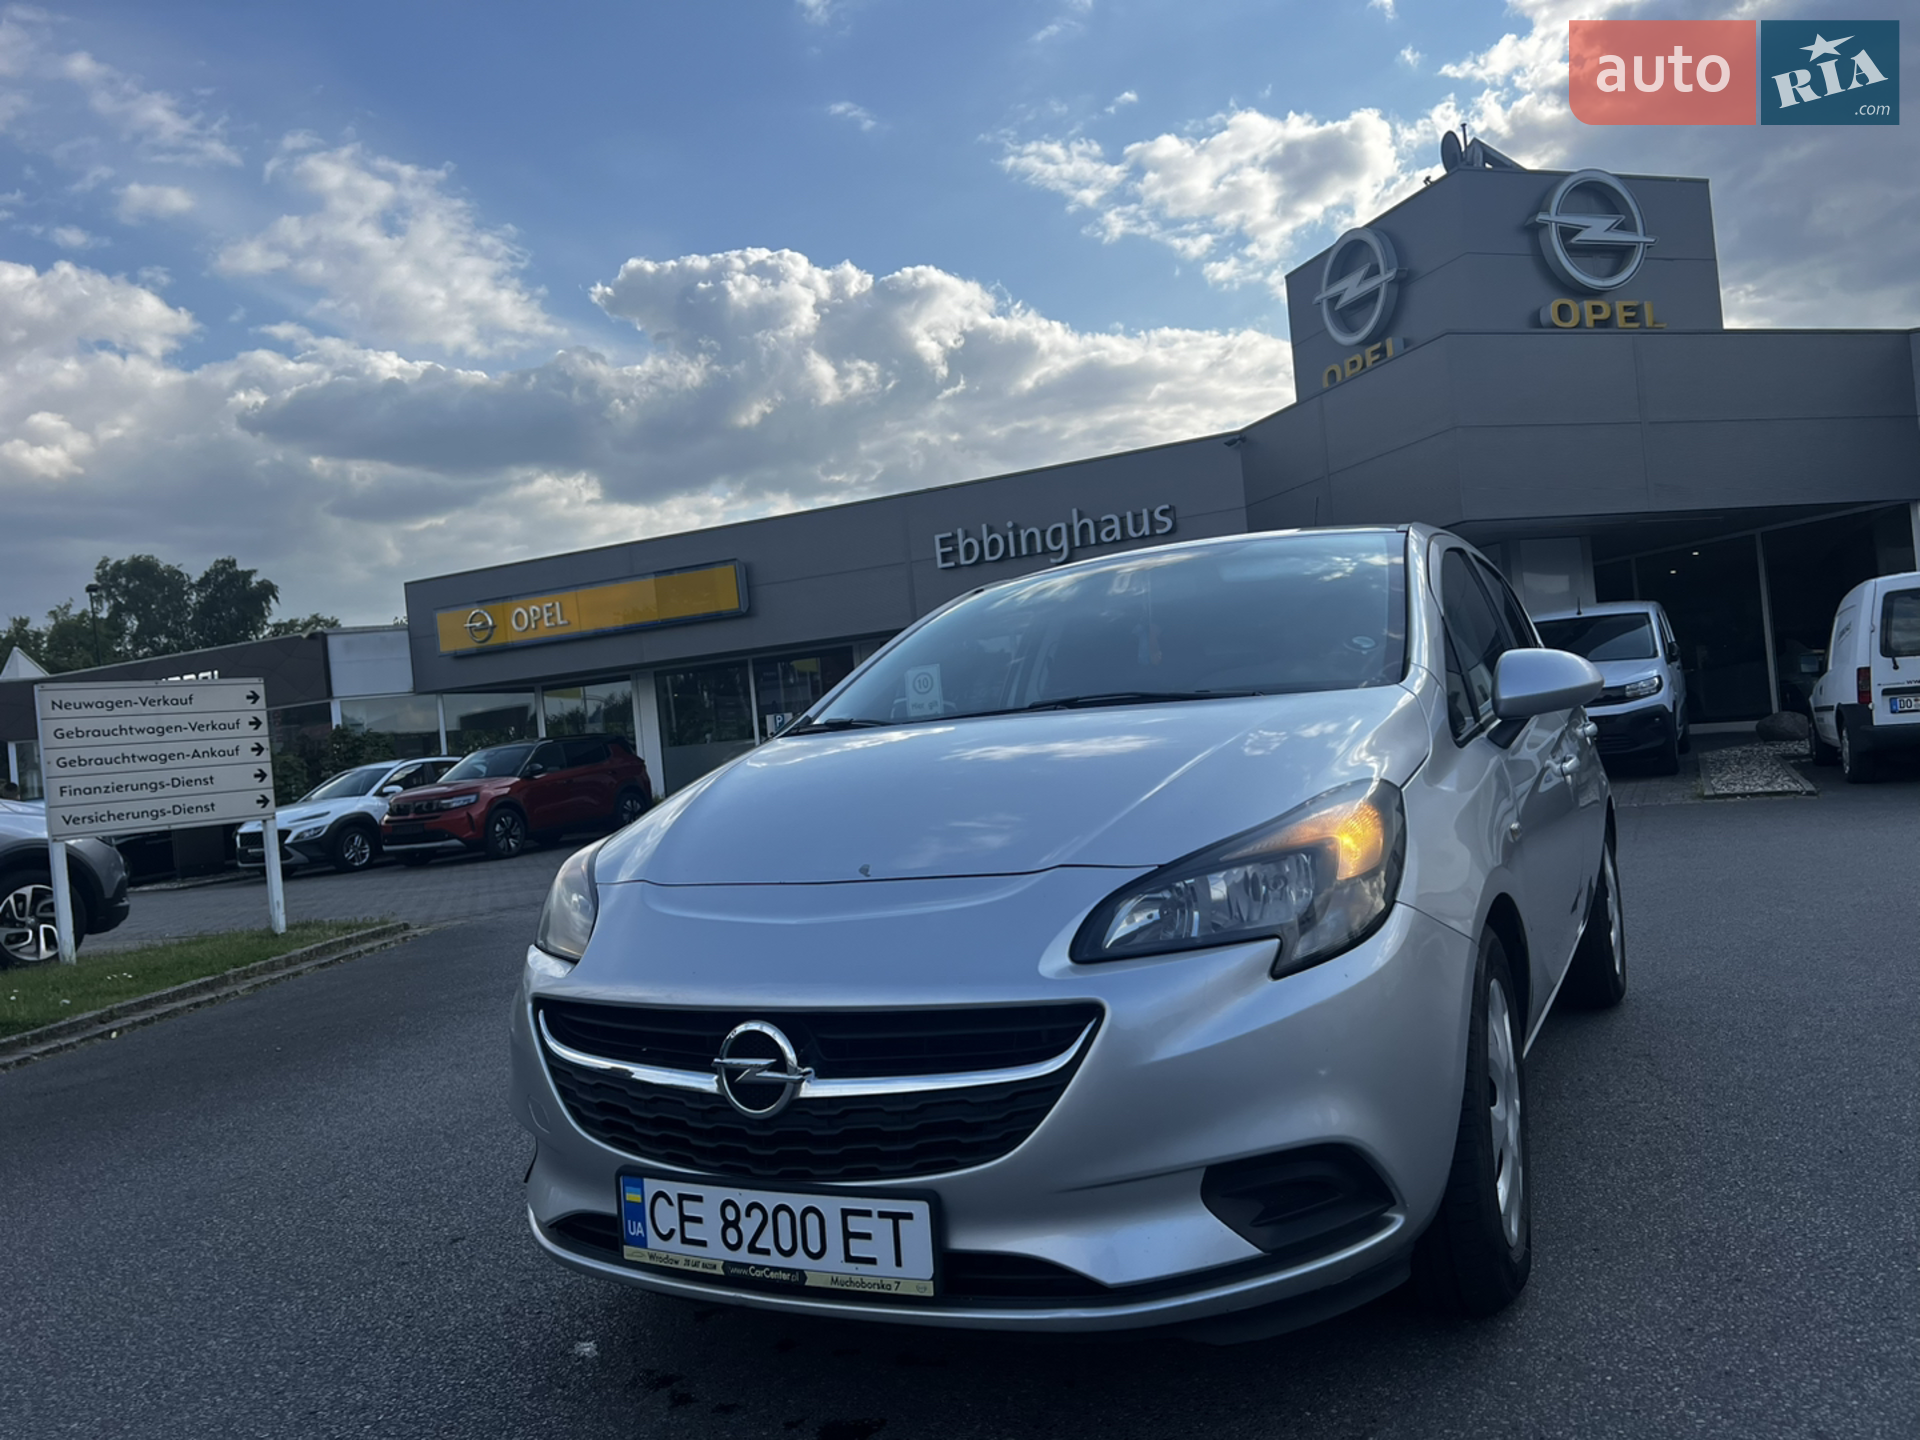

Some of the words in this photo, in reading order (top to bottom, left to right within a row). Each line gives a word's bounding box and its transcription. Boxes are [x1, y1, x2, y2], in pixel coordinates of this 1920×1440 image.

[1551, 298, 1668, 329] OPEL
[934, 503, 1175, 570] Ebbinghaus
[511, 601, 569, 632] OPEL
[51, 694, 194, 711] Neuwagen-Verkauf
[53, 718, 241, 740] Gebrauchtwagen-Verkauf
[776, 715, 783, 727] P
[56, 745, 241, 769] Gebrauchtwagen-Ankauf
[59, 775, 215, 797] Finanzierungs-Dienst
[61, 802, 216, 826] Versicherungs-Dienst
[628, 1219, 645, 1237] UA
[650, 1190, 708, 1248] CE
[720, 1199, 827, 1261] 8200
[840, 1208, 914, 1268] ET
[830, 1276, 892, 1291] Muchoborska
[893, 1281, 901, 1292] 7
